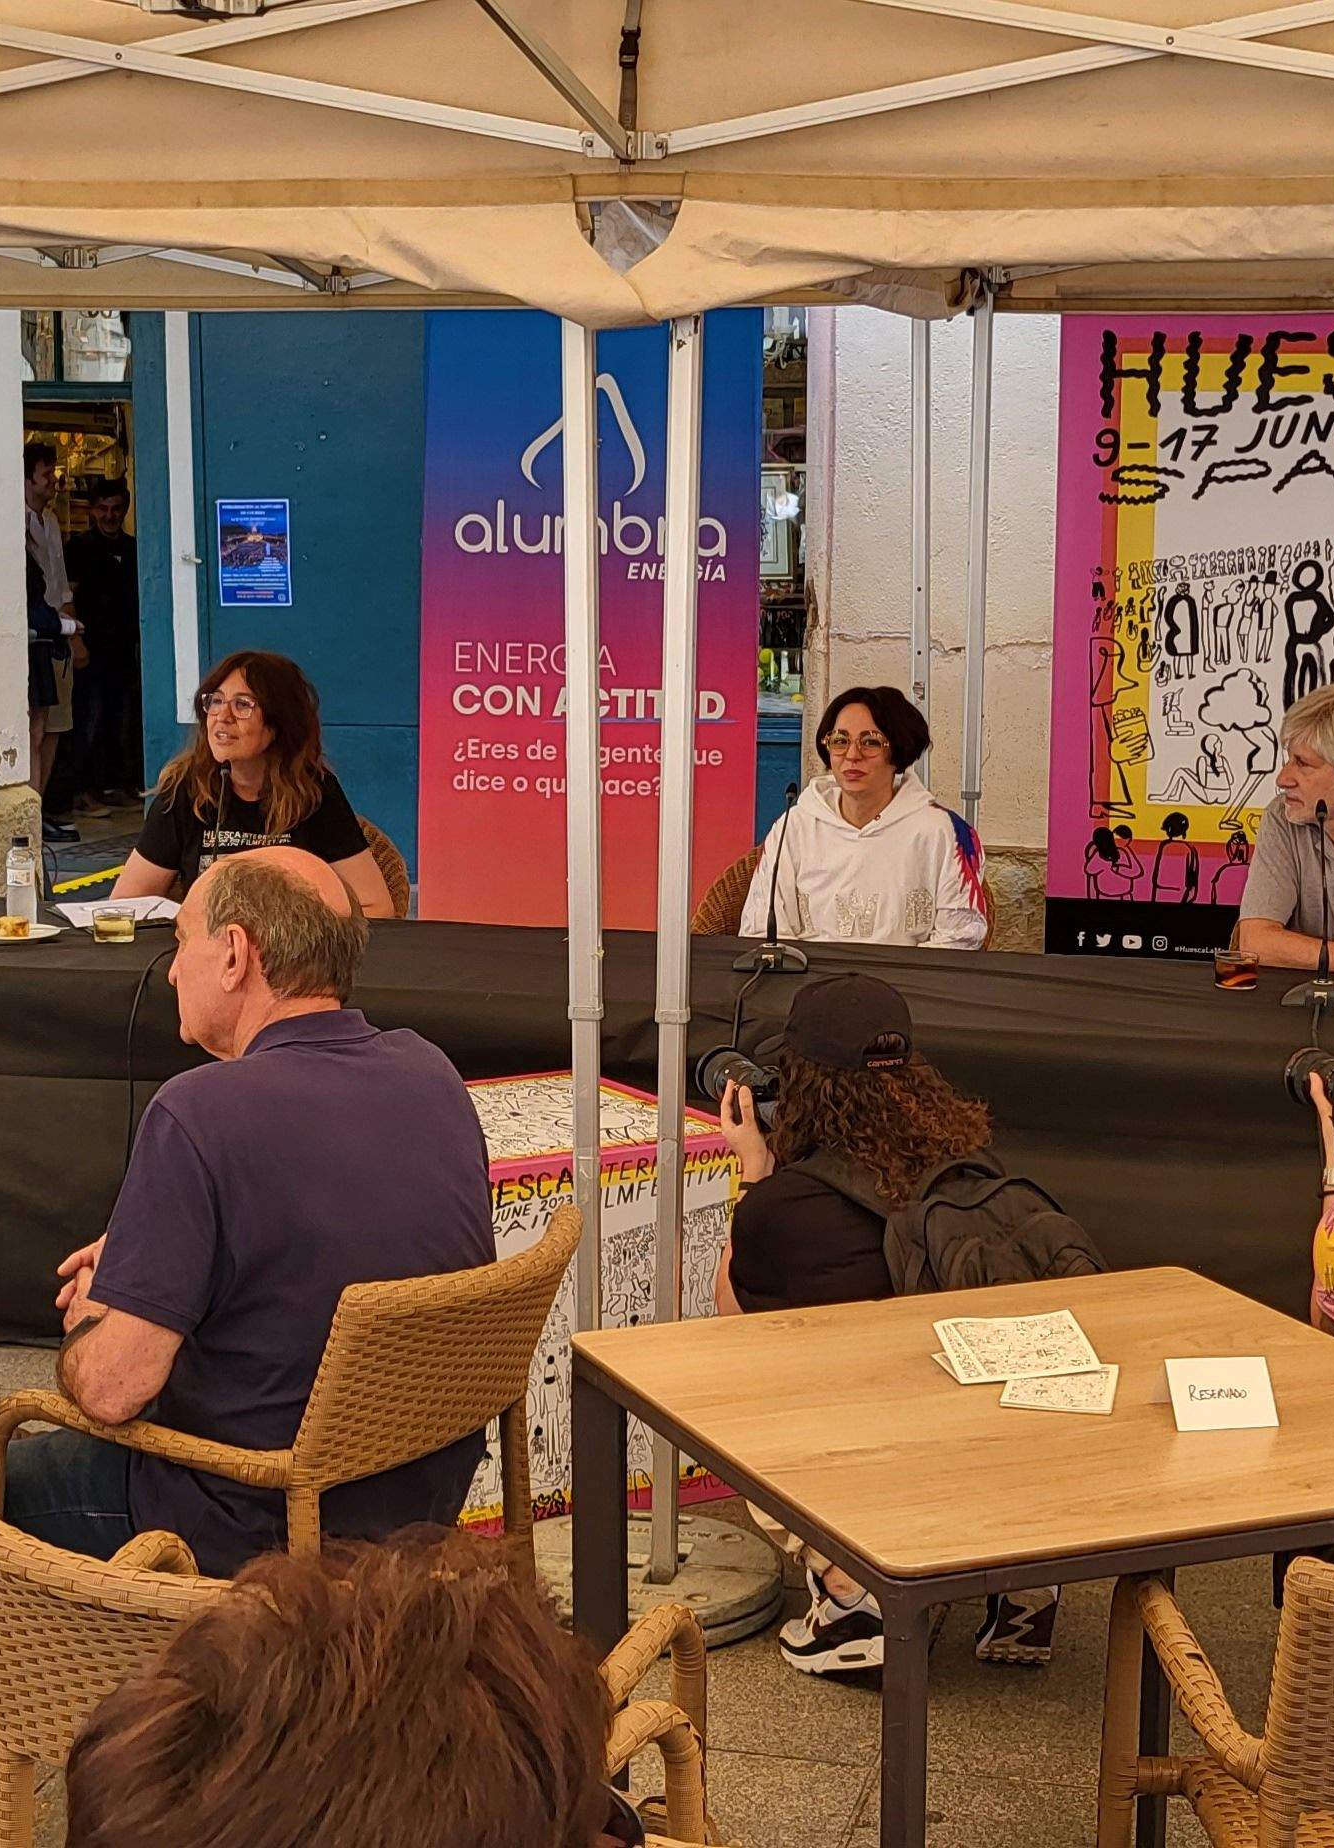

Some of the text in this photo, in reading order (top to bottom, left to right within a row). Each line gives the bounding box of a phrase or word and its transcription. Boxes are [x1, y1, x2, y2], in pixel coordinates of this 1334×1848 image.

[1092, 424, 1219, 468] 9-17
[627, 560, 727, 582] ENEGÍA
[455, 642, 617, 676] ENERGA
[452, 684, 541, 716] CON
[453, 738, 519, 762] ¿Eres
[526, 739, 558, 761] de
[694, 748, 723, 766] ue
[453, 770, 506, 792] dice
[513, 776, 529, 792] o
[535, 776, 566, 798] qu
[491, 1167, 574, 1210] ESCA
[492, 1203, 533, 1225] JUNE
[493, 1212, 552, 1238] PAI
